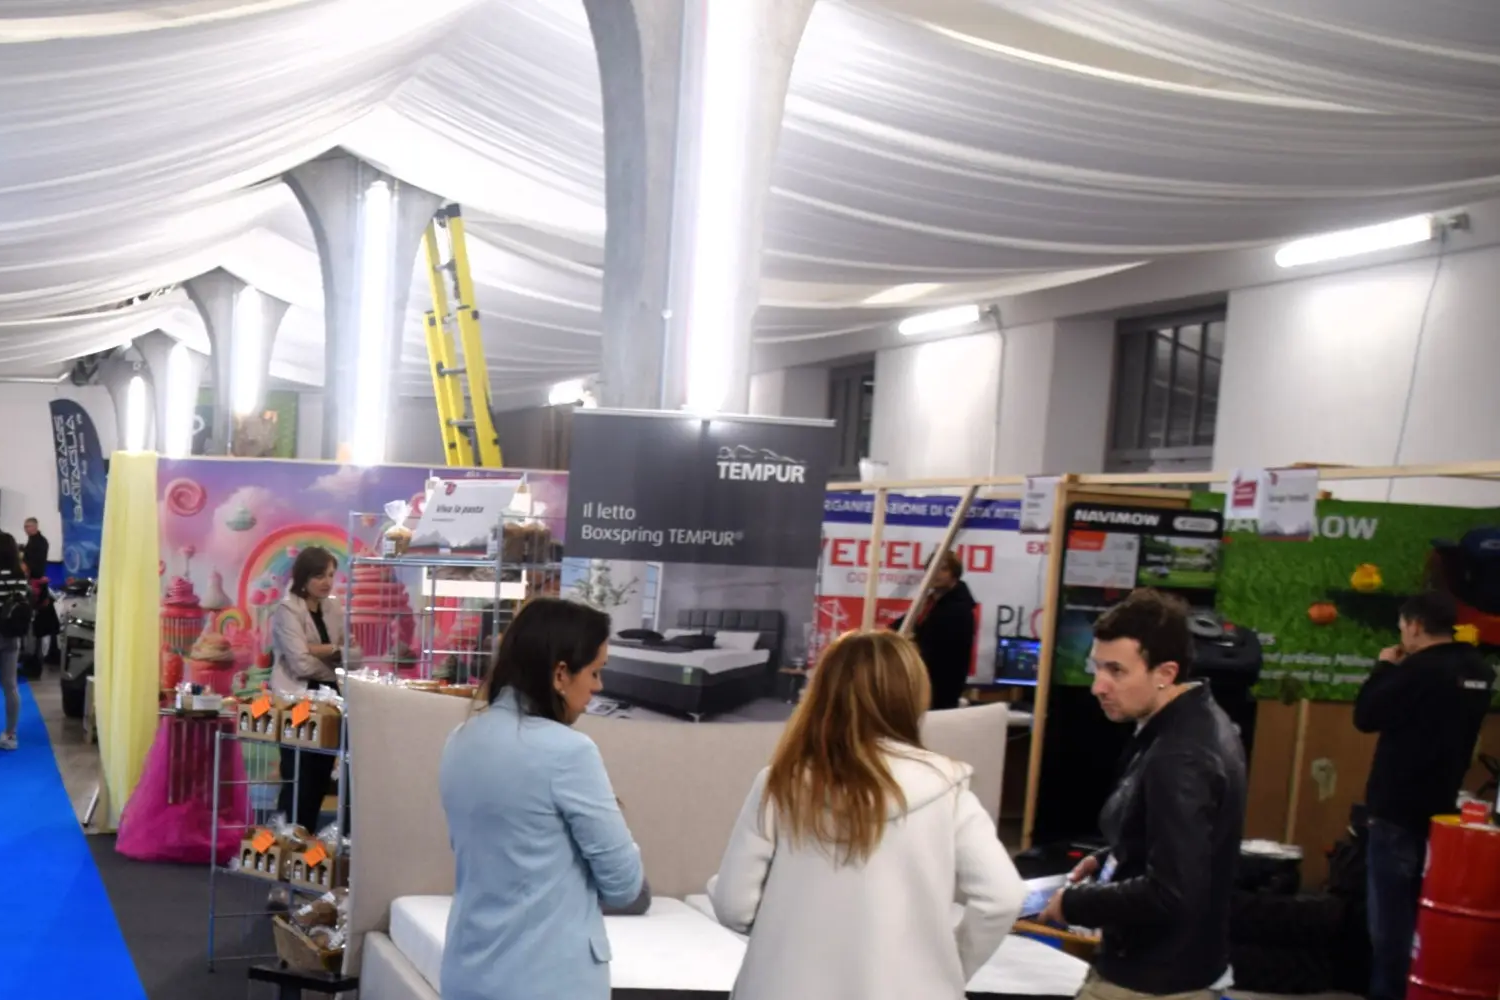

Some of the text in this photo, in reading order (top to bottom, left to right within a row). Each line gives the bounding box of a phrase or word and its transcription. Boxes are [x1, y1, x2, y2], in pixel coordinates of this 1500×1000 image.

[717, 461, 806, 483] TEMPUR
[583, 503, 636, 521] Il letto
[1074, 509, 1162, 527] NAVIMOW
[581, 524, 664, 547] Boxspring
